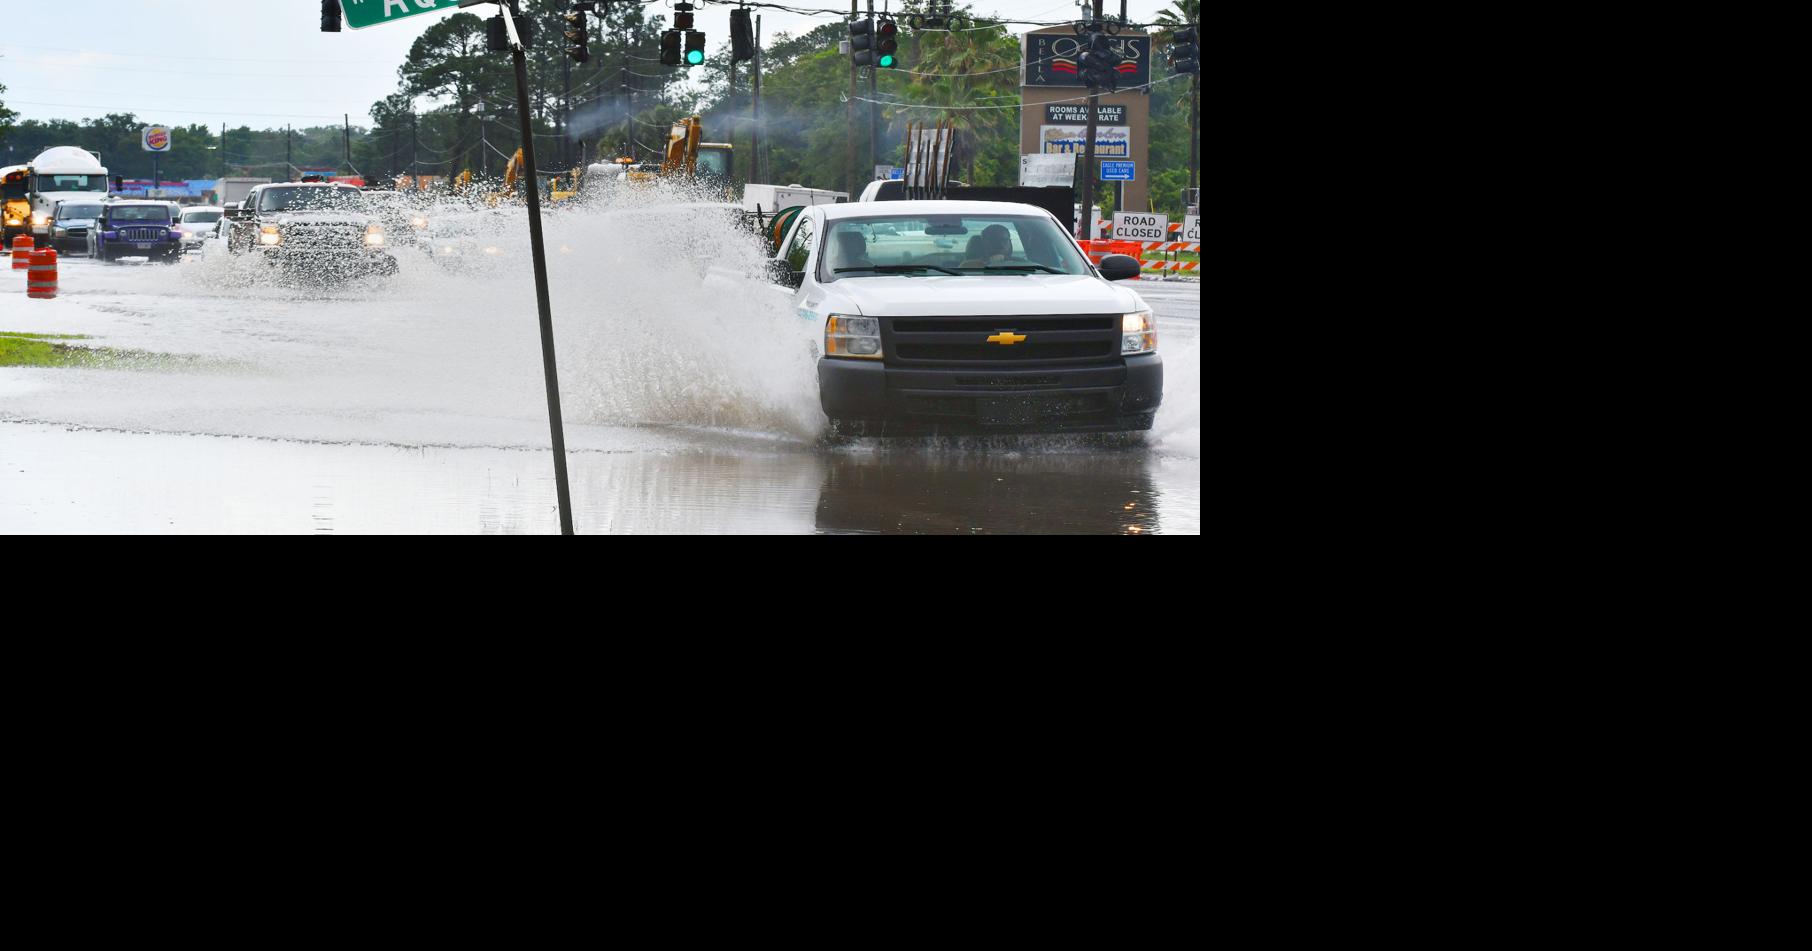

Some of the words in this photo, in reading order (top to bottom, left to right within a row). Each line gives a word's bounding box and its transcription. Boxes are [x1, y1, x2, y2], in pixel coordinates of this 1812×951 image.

[1051, 37, 1141, 59] OSIS
[1049, 106, 1078, 114] ROOMS
[1046, 142, 1062, 154] Bar
[1073, 143, 1125, 155] Reaurant
[1124, 215, 1156, 226] ROAD
[1116, 227, 1162, 238] CLOSED
